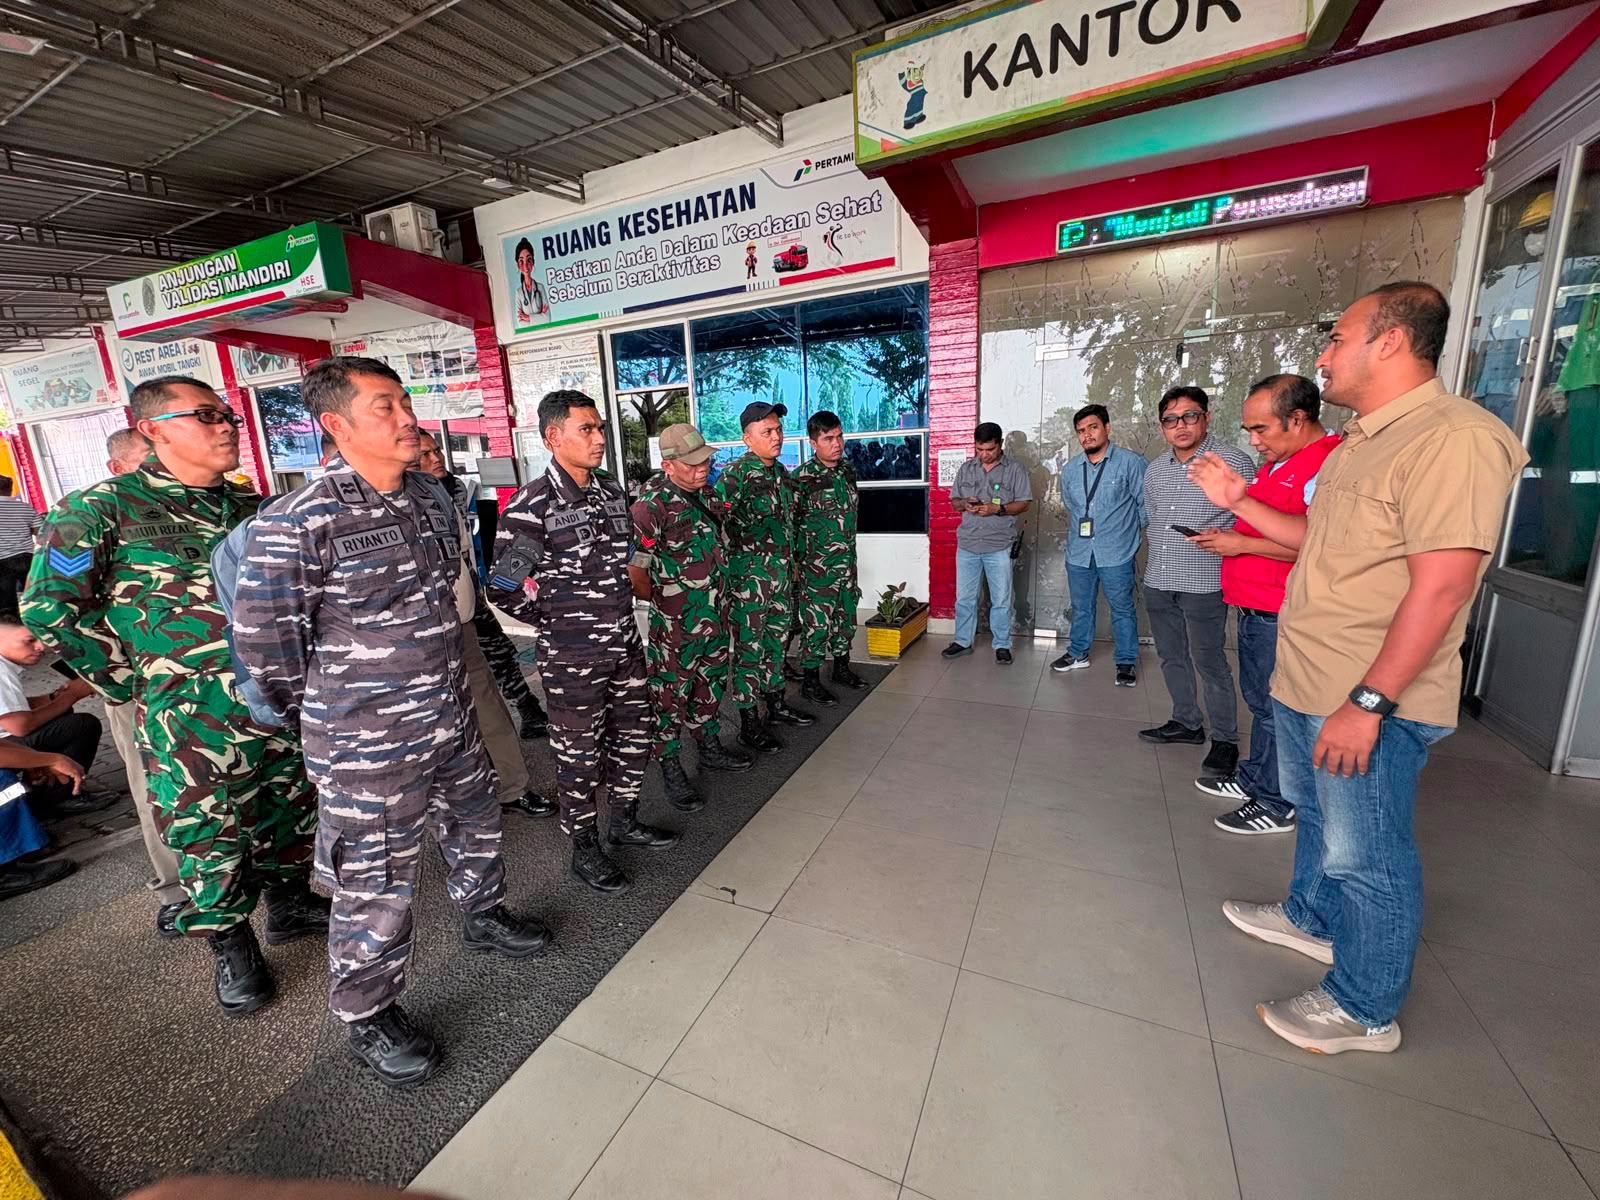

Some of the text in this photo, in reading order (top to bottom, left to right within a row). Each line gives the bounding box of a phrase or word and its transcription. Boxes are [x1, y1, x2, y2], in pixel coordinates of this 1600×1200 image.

[963, 0, 1242, 99] KANTOR
[815, 152, 854, 171] PERTAMI
[542, 182, 757, 261] RUANG KESEHATAN
[546, 189, 882, 286] Pastikan Anda Dalam Keadaan Sehat
[159, 253, 237, 292] ANJUNGAN
[300, 275, 315, 287] HSE
[549, 253, 721, 305] Sebelum Beraktivitas
[161, 259, 292, 310] VALIDASI MANDIRI
[134, 348, 156, 365] REST
[158, 342, 181, 360] AREA
[12, 364, 39, 377] RUANG
[139, 356, 202, 378] AWAK MOBIL TANGKI
[18, 376, 41, 387] SEGEL
[159, 524, 193, 535] RIZAL
[555, 513, 580, 527] ANDI
[342, 529, 399, 554] RIYANTO
